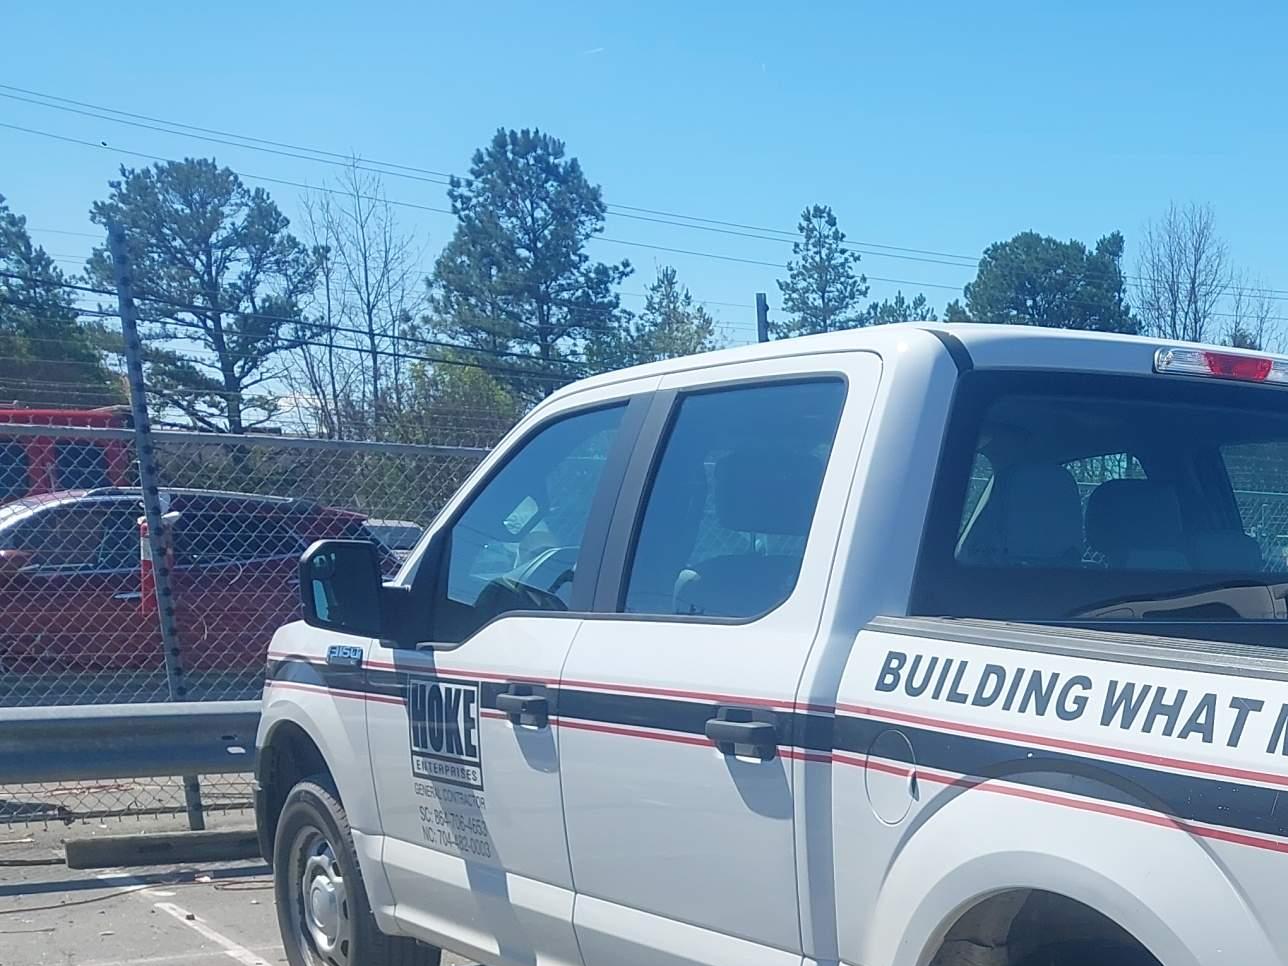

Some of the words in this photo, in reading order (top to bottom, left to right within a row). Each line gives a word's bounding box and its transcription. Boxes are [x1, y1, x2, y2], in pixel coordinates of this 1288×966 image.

[875, 650, 1093, 721] BUILDING
[1100, 680, 1264, 746] WHAT
[411, 683, 478, 758] HOKE
[416, 759, 478, 781] ENTERPRISES
[419, 805, 434, 823] SC:
[422, 825, 436, 843] NC:
